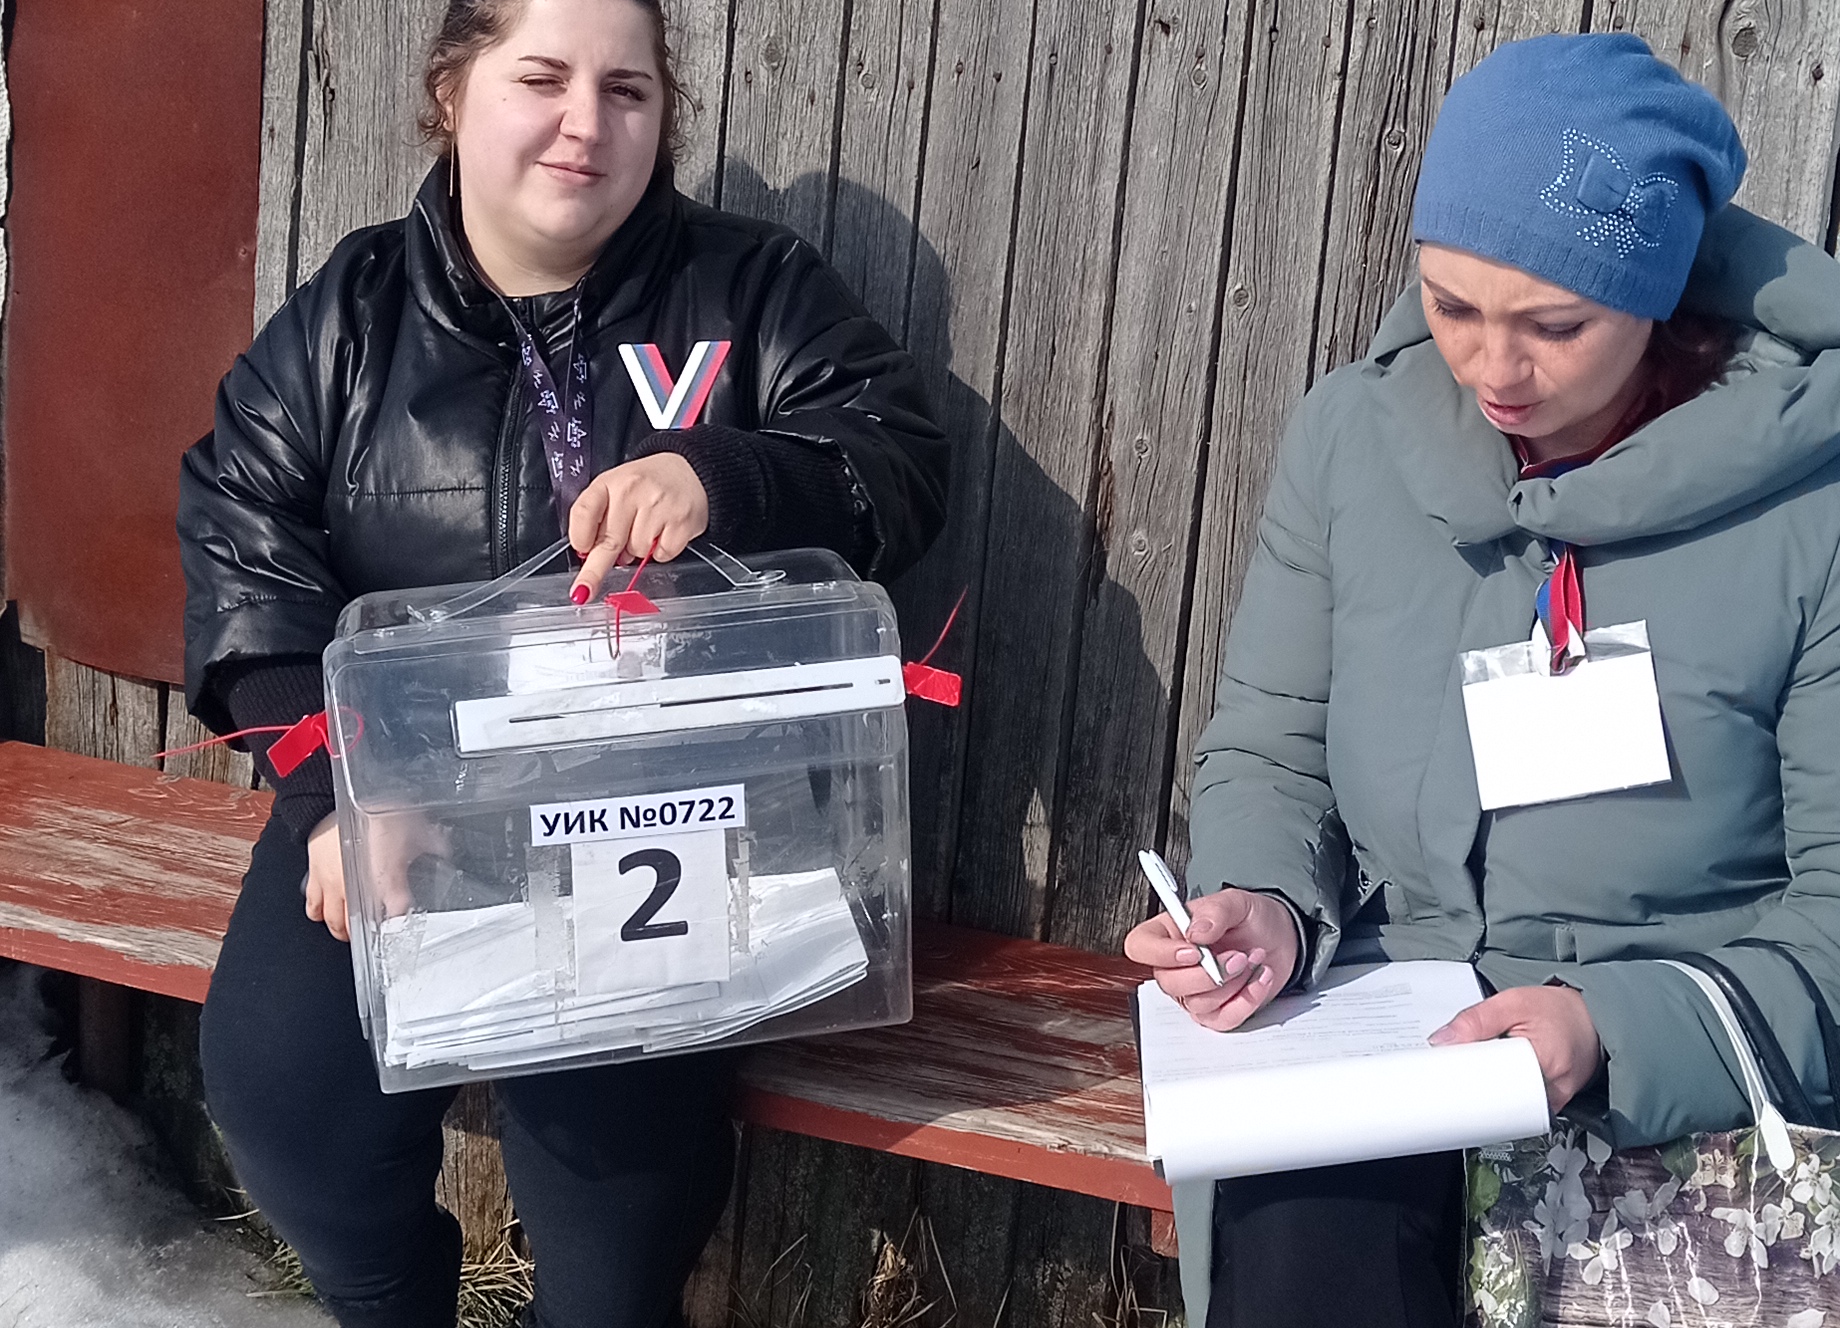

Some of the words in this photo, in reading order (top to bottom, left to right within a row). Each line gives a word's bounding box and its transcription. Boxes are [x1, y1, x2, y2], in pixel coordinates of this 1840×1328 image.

[617, 339, 733, 430] V
[539, 808, 609, 837] УИК
[619, 796, 736, 830] №0722
[618, 847, 689, 942] 2
